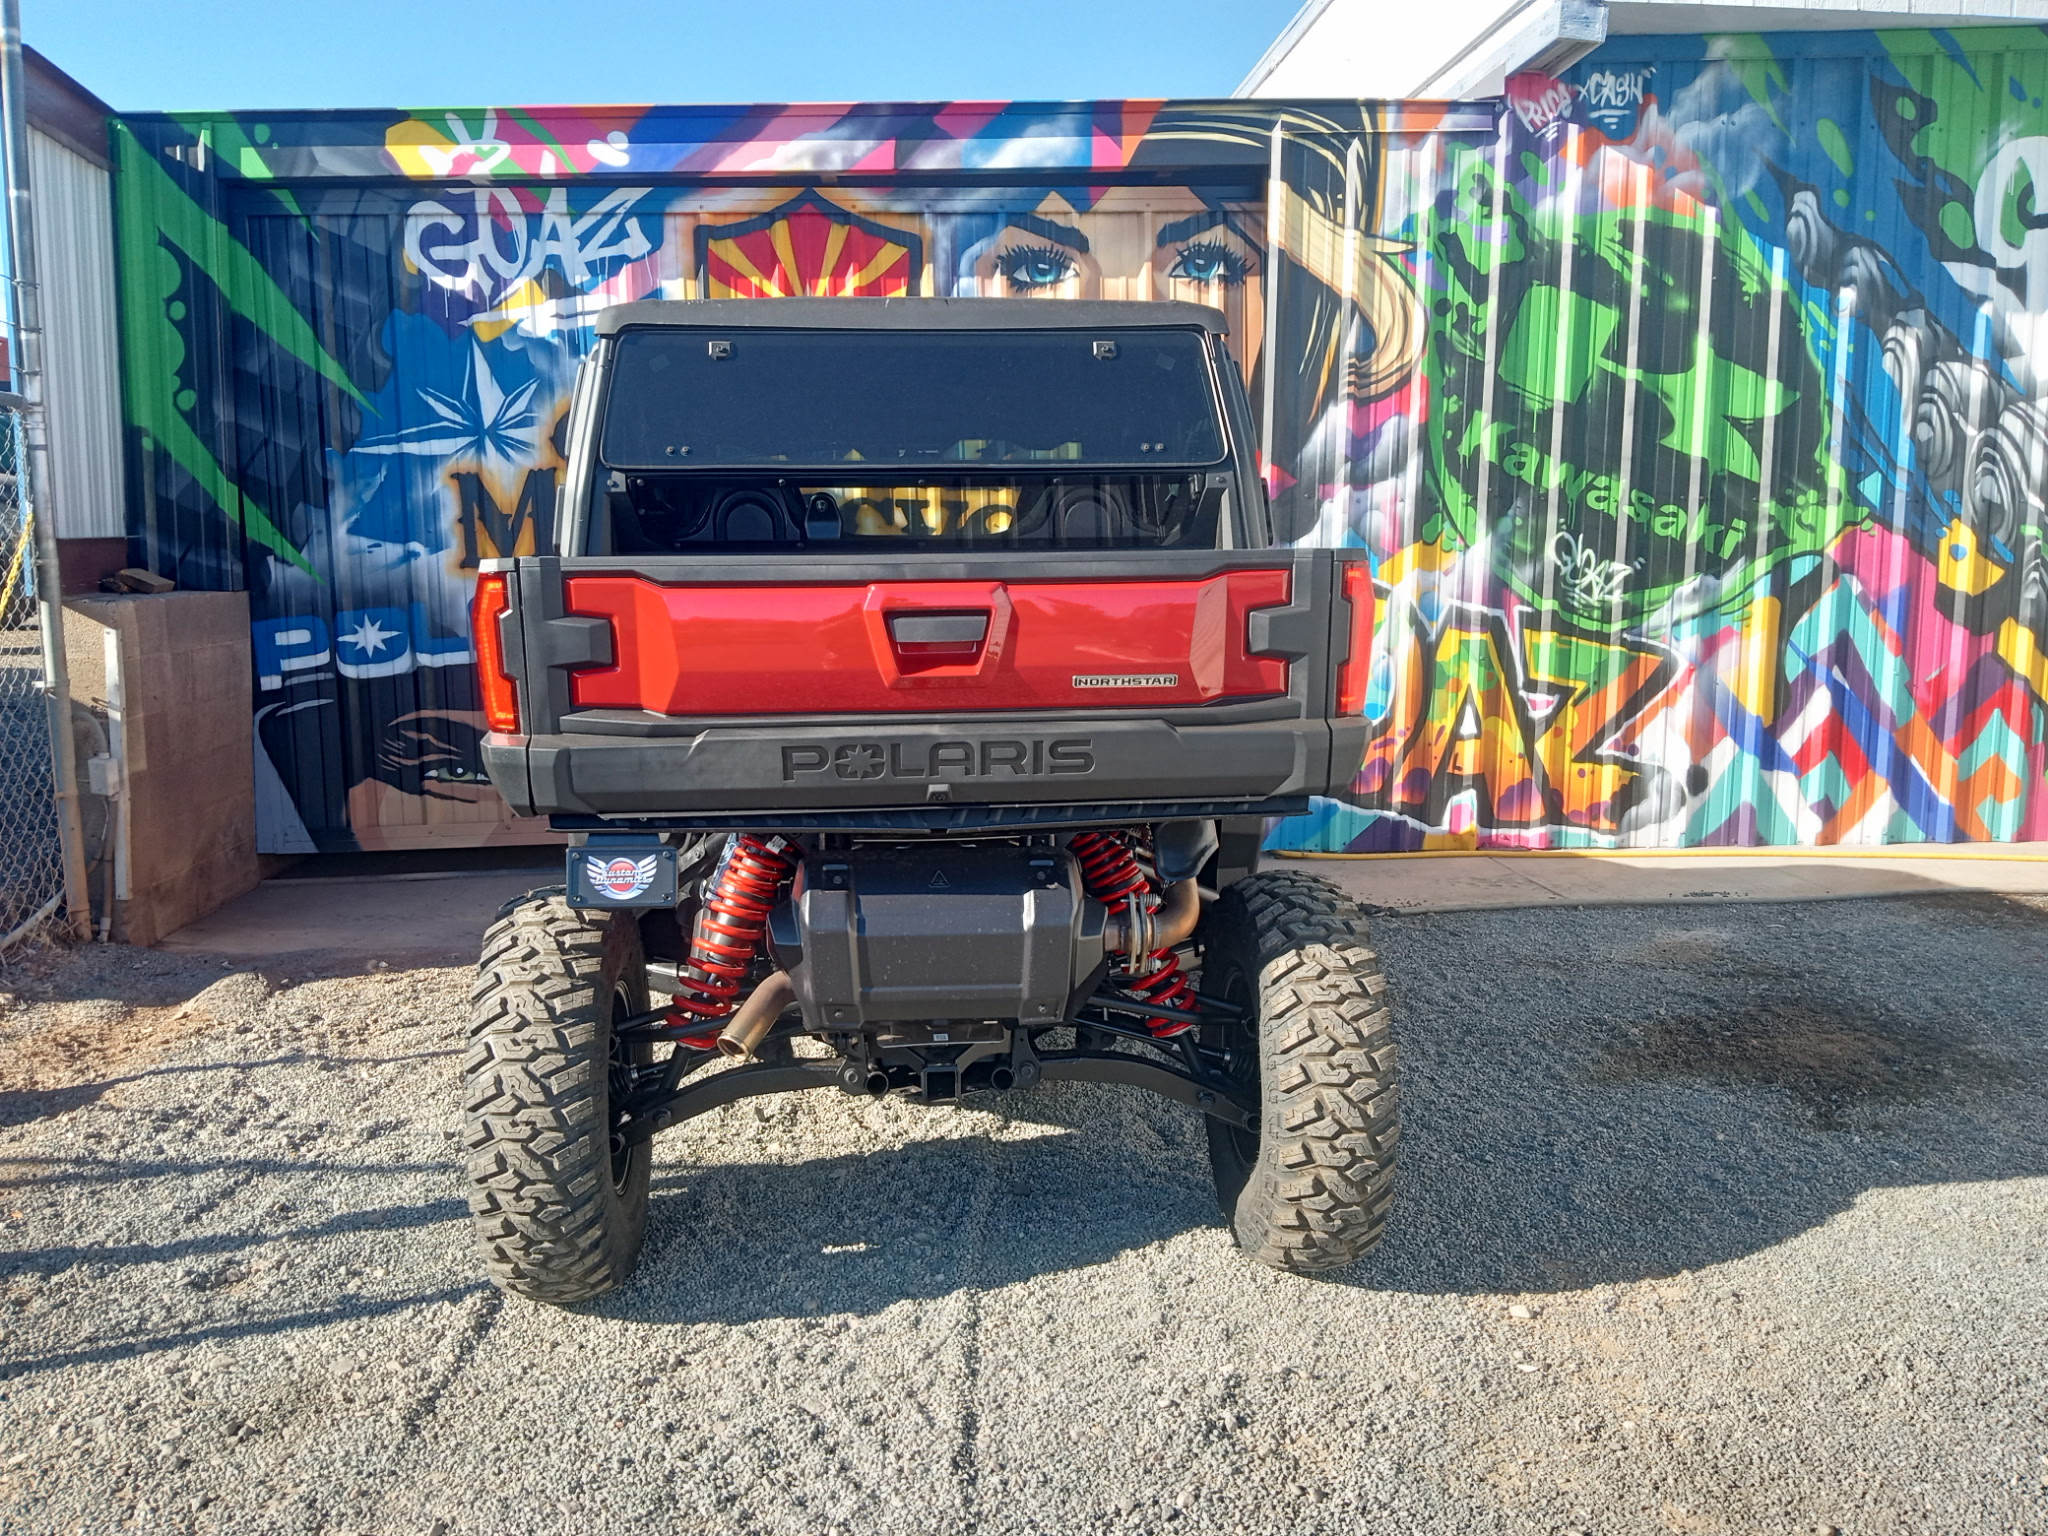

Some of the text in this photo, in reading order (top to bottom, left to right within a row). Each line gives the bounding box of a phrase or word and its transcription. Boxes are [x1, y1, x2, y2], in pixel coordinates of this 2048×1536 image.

[1076, 677, 1175, 687] NORTHSTAR
[781, 739, 1096, 782] POLARIS
[595, 875, 651, 884] Dynamics
